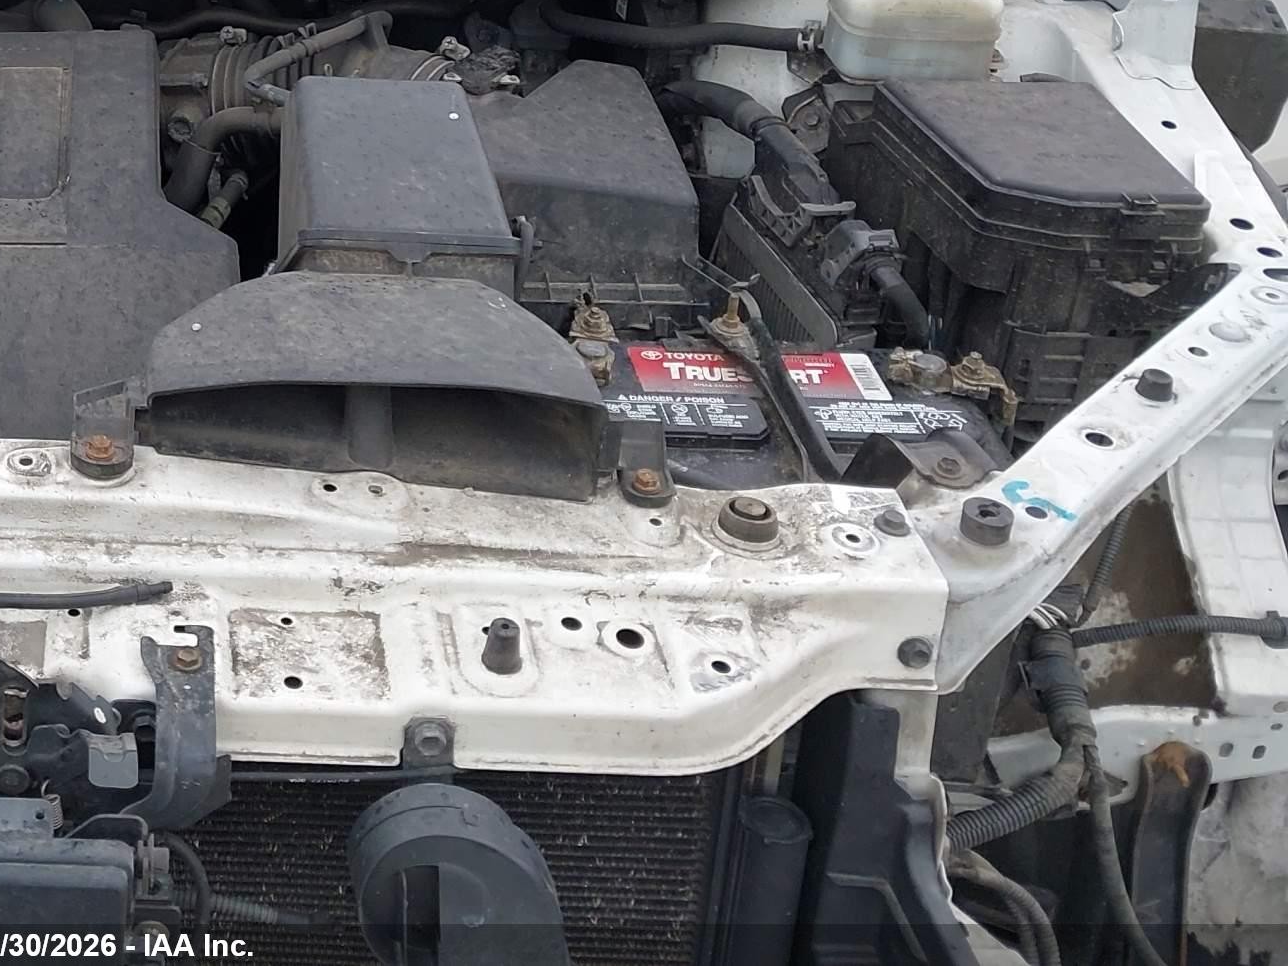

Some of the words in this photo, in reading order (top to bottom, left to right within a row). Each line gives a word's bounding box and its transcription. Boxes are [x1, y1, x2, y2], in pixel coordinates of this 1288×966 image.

[664, 352, 724, 362] TOYOTA
[629, 394, 673, 403] DANGER
[684, 396, 725, 404] POISON
